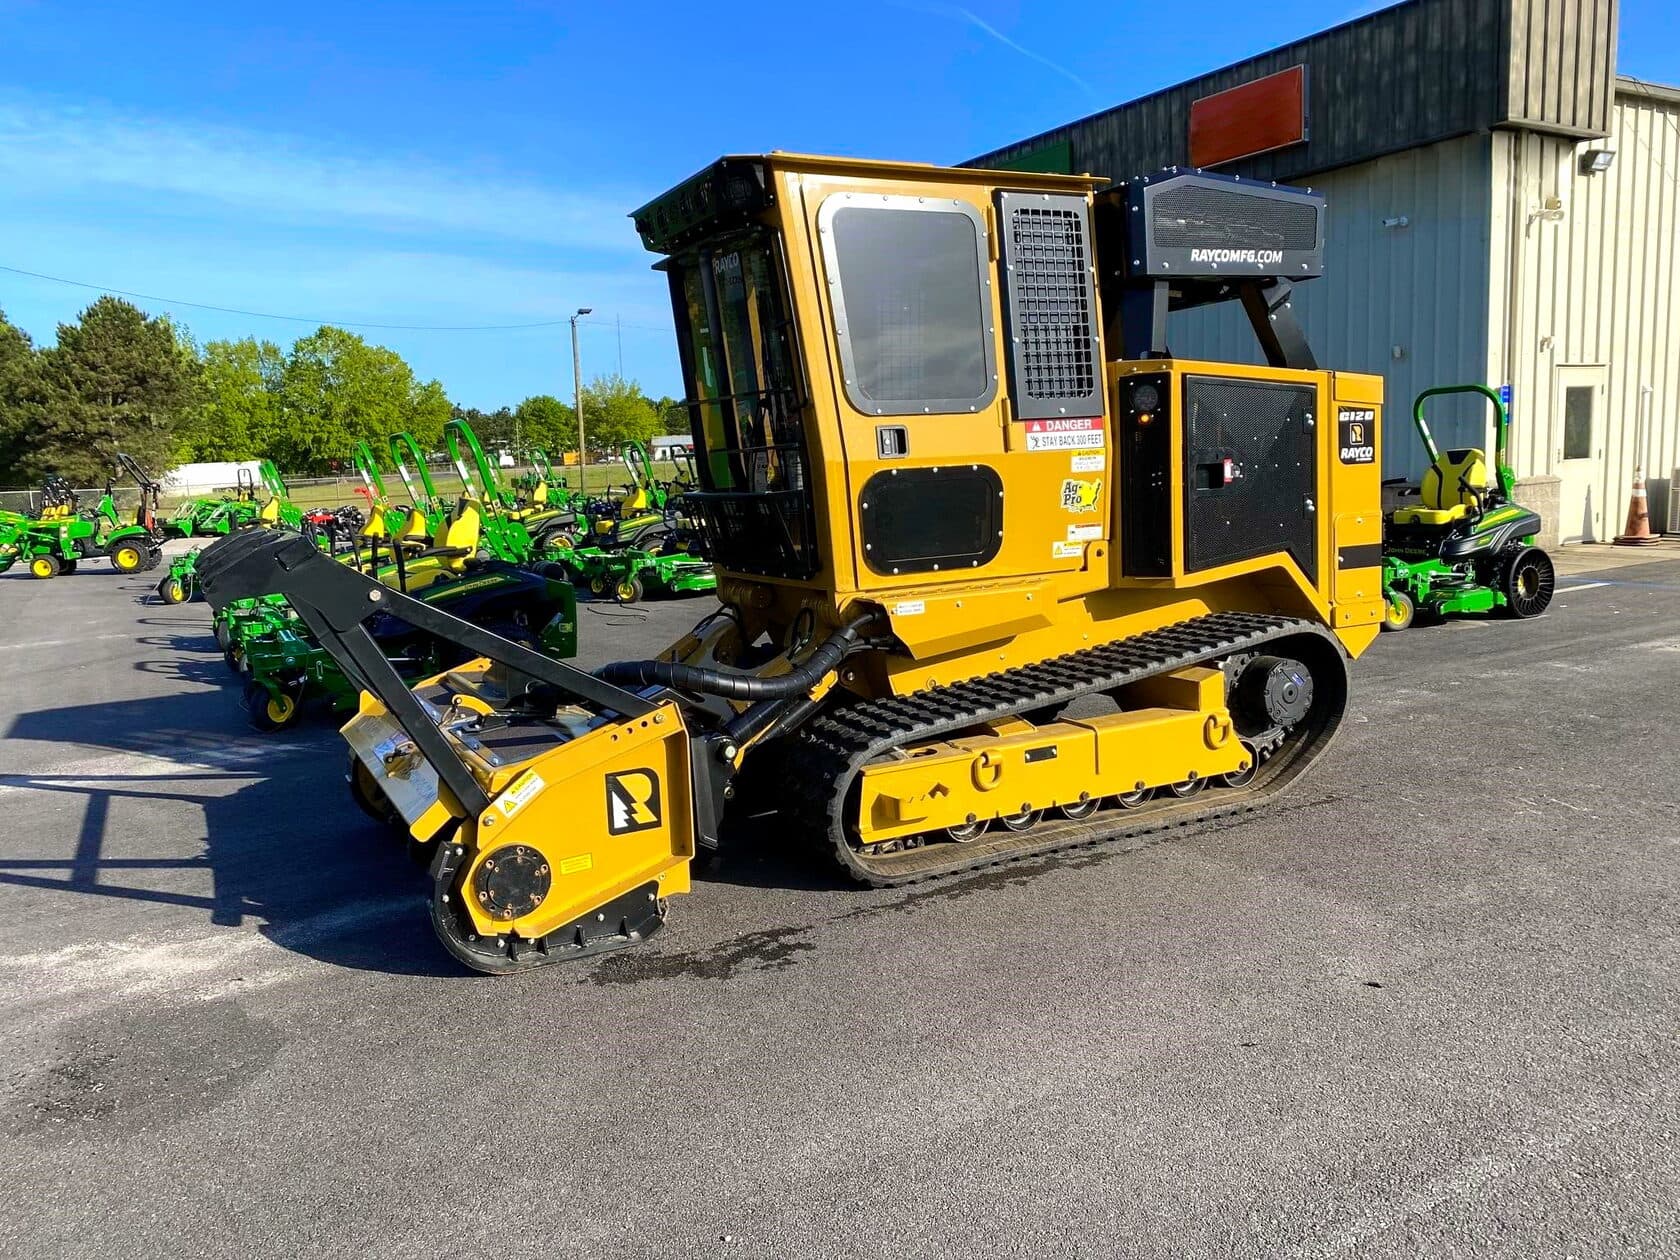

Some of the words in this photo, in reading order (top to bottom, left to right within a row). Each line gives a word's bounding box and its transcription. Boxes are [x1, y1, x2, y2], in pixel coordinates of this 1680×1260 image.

[1190, 248, 1283, 263] RAYCOMFG.COM
[714, 252, 739, 274] RAYCO
[1046, 419, 1092, 431] DANGER
[1042, 436, 1058, 447] STAY
[1059, 435, 1076, 446] BACK
[1087, 433, 1102, 445] FEET
[1341, 447, 1373, 459] RAYCO
[1063, 493, 1082, 505] Pro
